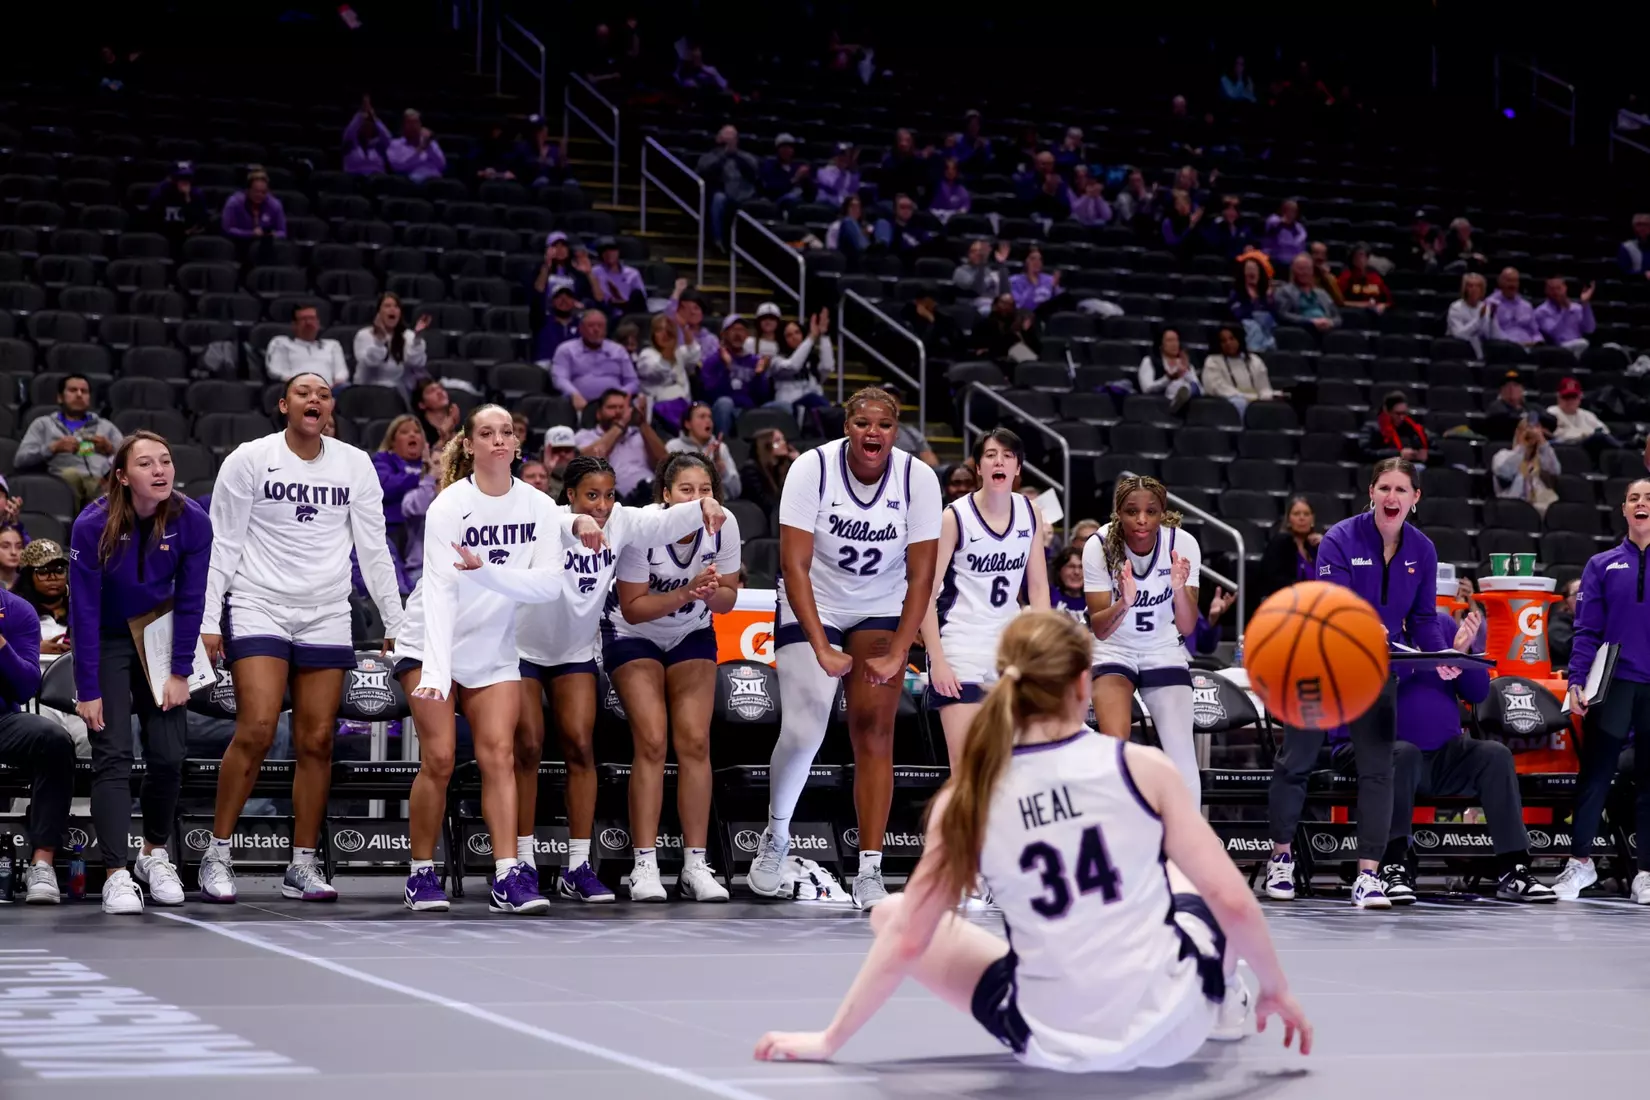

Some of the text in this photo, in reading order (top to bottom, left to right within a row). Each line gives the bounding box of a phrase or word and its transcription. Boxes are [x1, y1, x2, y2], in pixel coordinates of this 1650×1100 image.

[264, 480, 309, 504] LOCK
[313, 486, 328, 504] IT
[503, 524, 519, 545] IT
[829, 514, 898, 542] Wildcats
[564, 550, 592, 574] OCK
[838, 545, 883, 577] 22
[990, 575, 1010, 608] 6
[1113, 585, 1173, 608] ldcats
[1136, 611, 1154, 632] 5
[1518, 606, 1543, 637] G
[740, 621, 775, 665] G
[351, 670, 389, 690] XII
[731, 677, 766, 696] XII
[1505, 694, 1536, 710] XII
[1018, 784, 1083, 831] HEAL
[230, 833, 290, 849] llstate
[367, 834, 412, 849] Allst
[533, 838, 568, 853] tate
[789, 834, 828, 849] state
[883, 832, 925, 846] llstat
[1227, 837, 1275, 850] Allstat
[1019, 824, 1123, 921] 34
